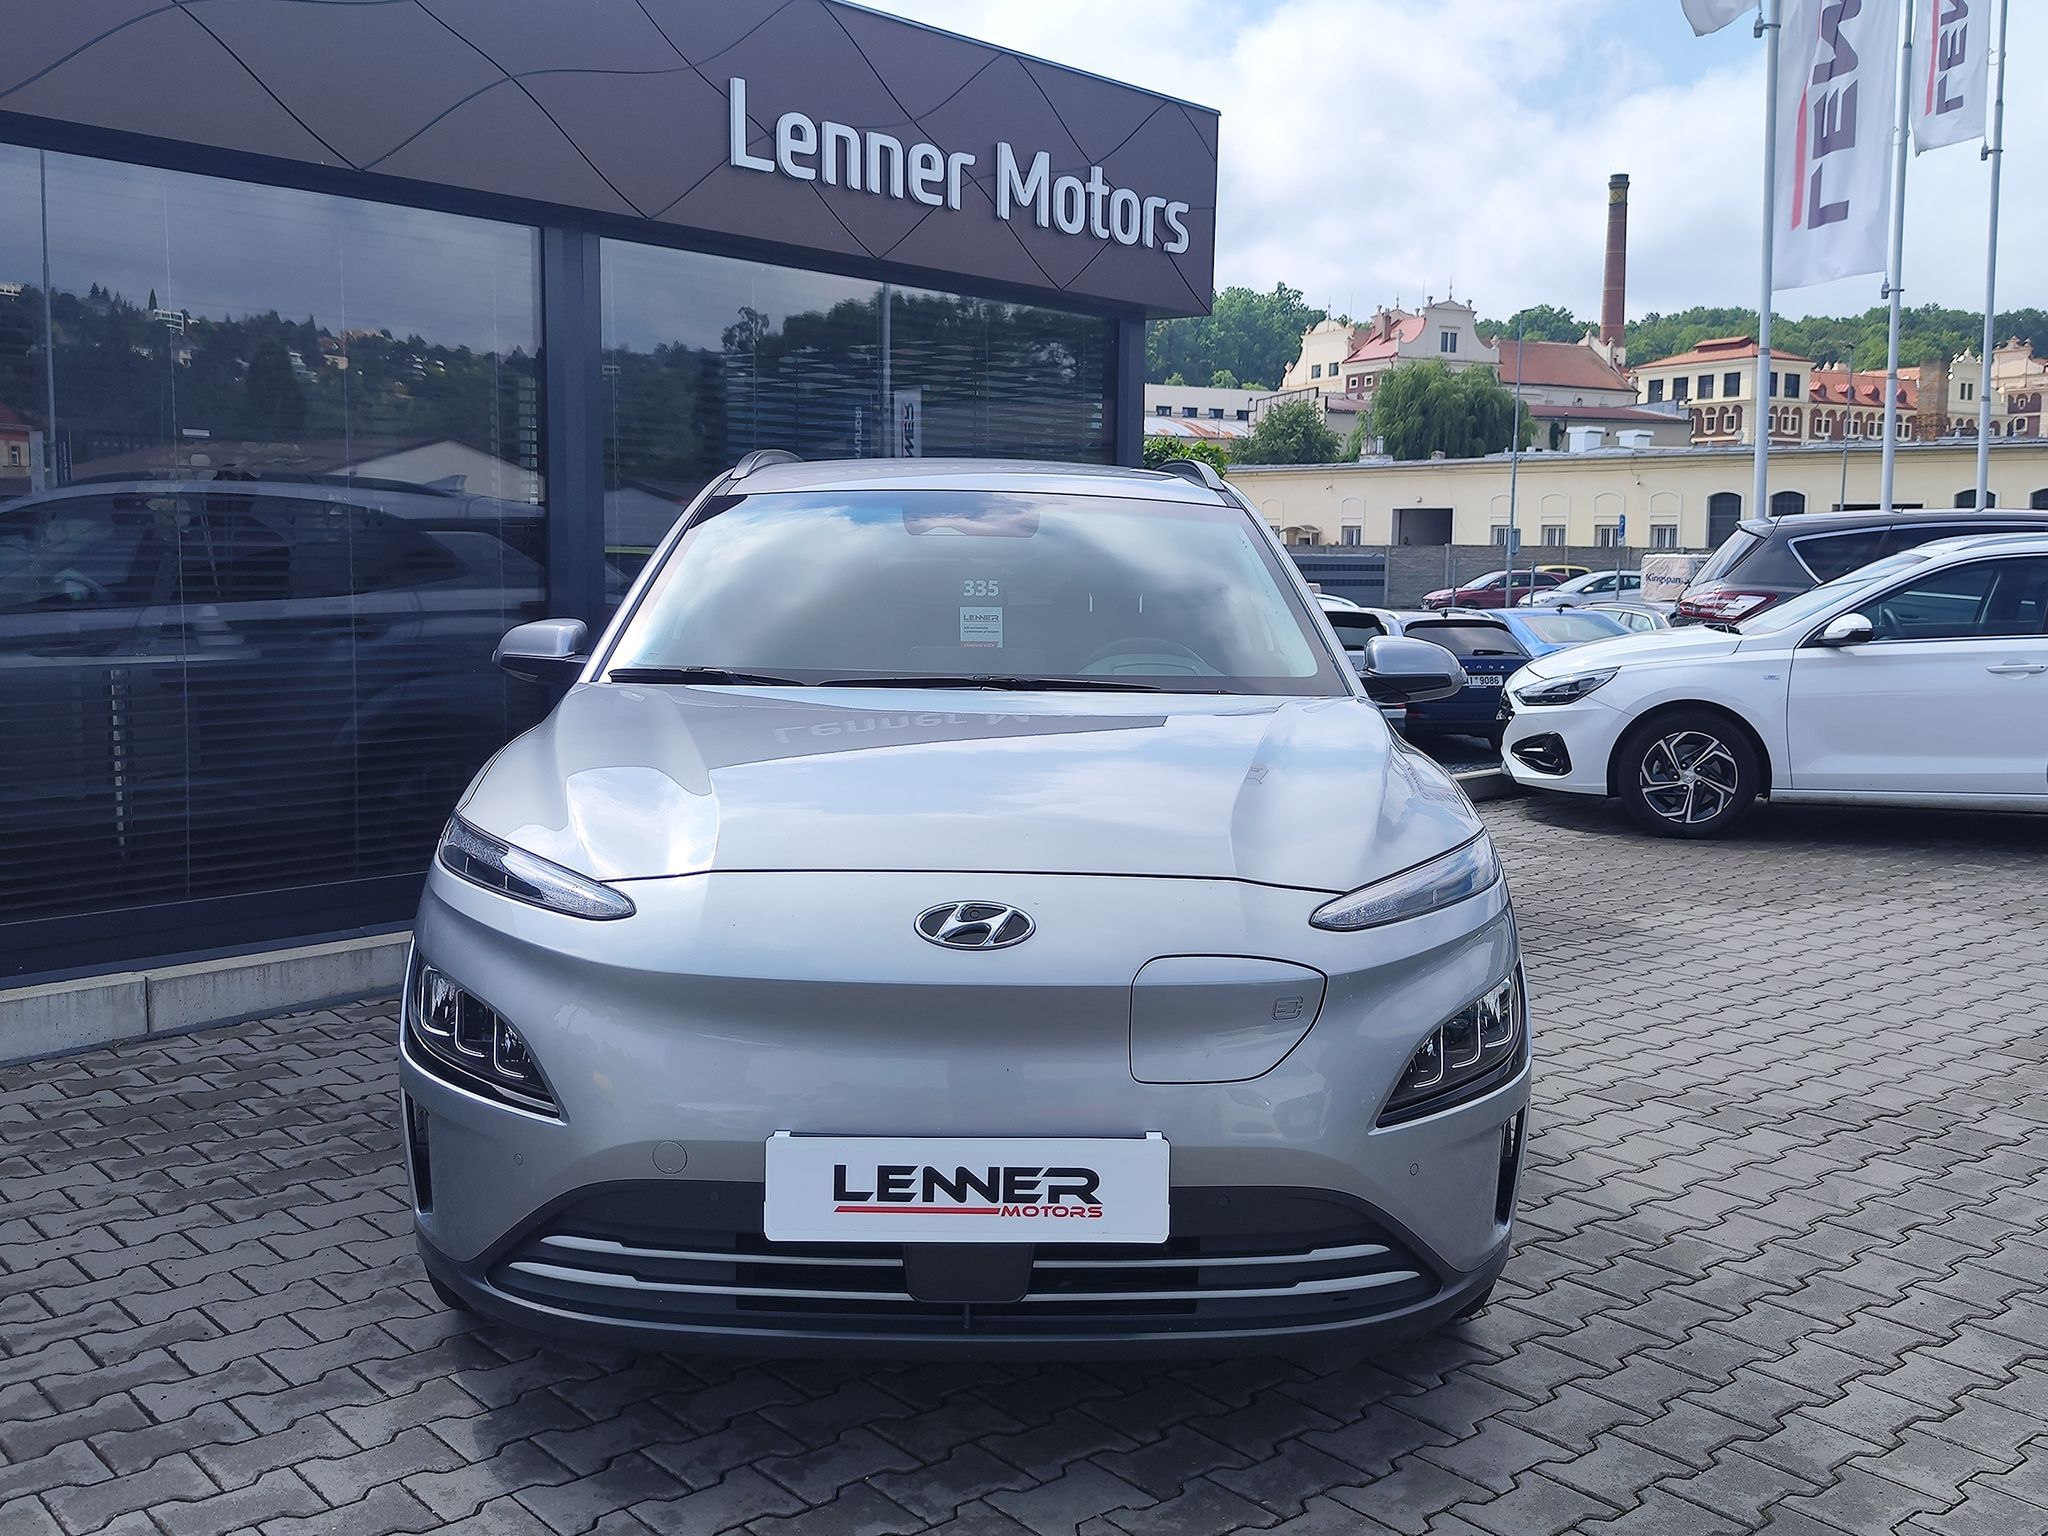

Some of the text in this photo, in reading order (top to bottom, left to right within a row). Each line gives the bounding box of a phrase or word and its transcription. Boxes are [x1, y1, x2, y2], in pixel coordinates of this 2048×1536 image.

[728, 76, 1191, 255] Lenner Motors
[1645, 573, 1681, 585] Kingspan
[963, 579, 1000, 597] 335
[963, 614, 1000, 623] LENNER
[1479, 676, 1500, 685] 9086
[833, 1164, 1103, 1205] LENNER
[999, 1205, 1104, 1219] MOTORS
